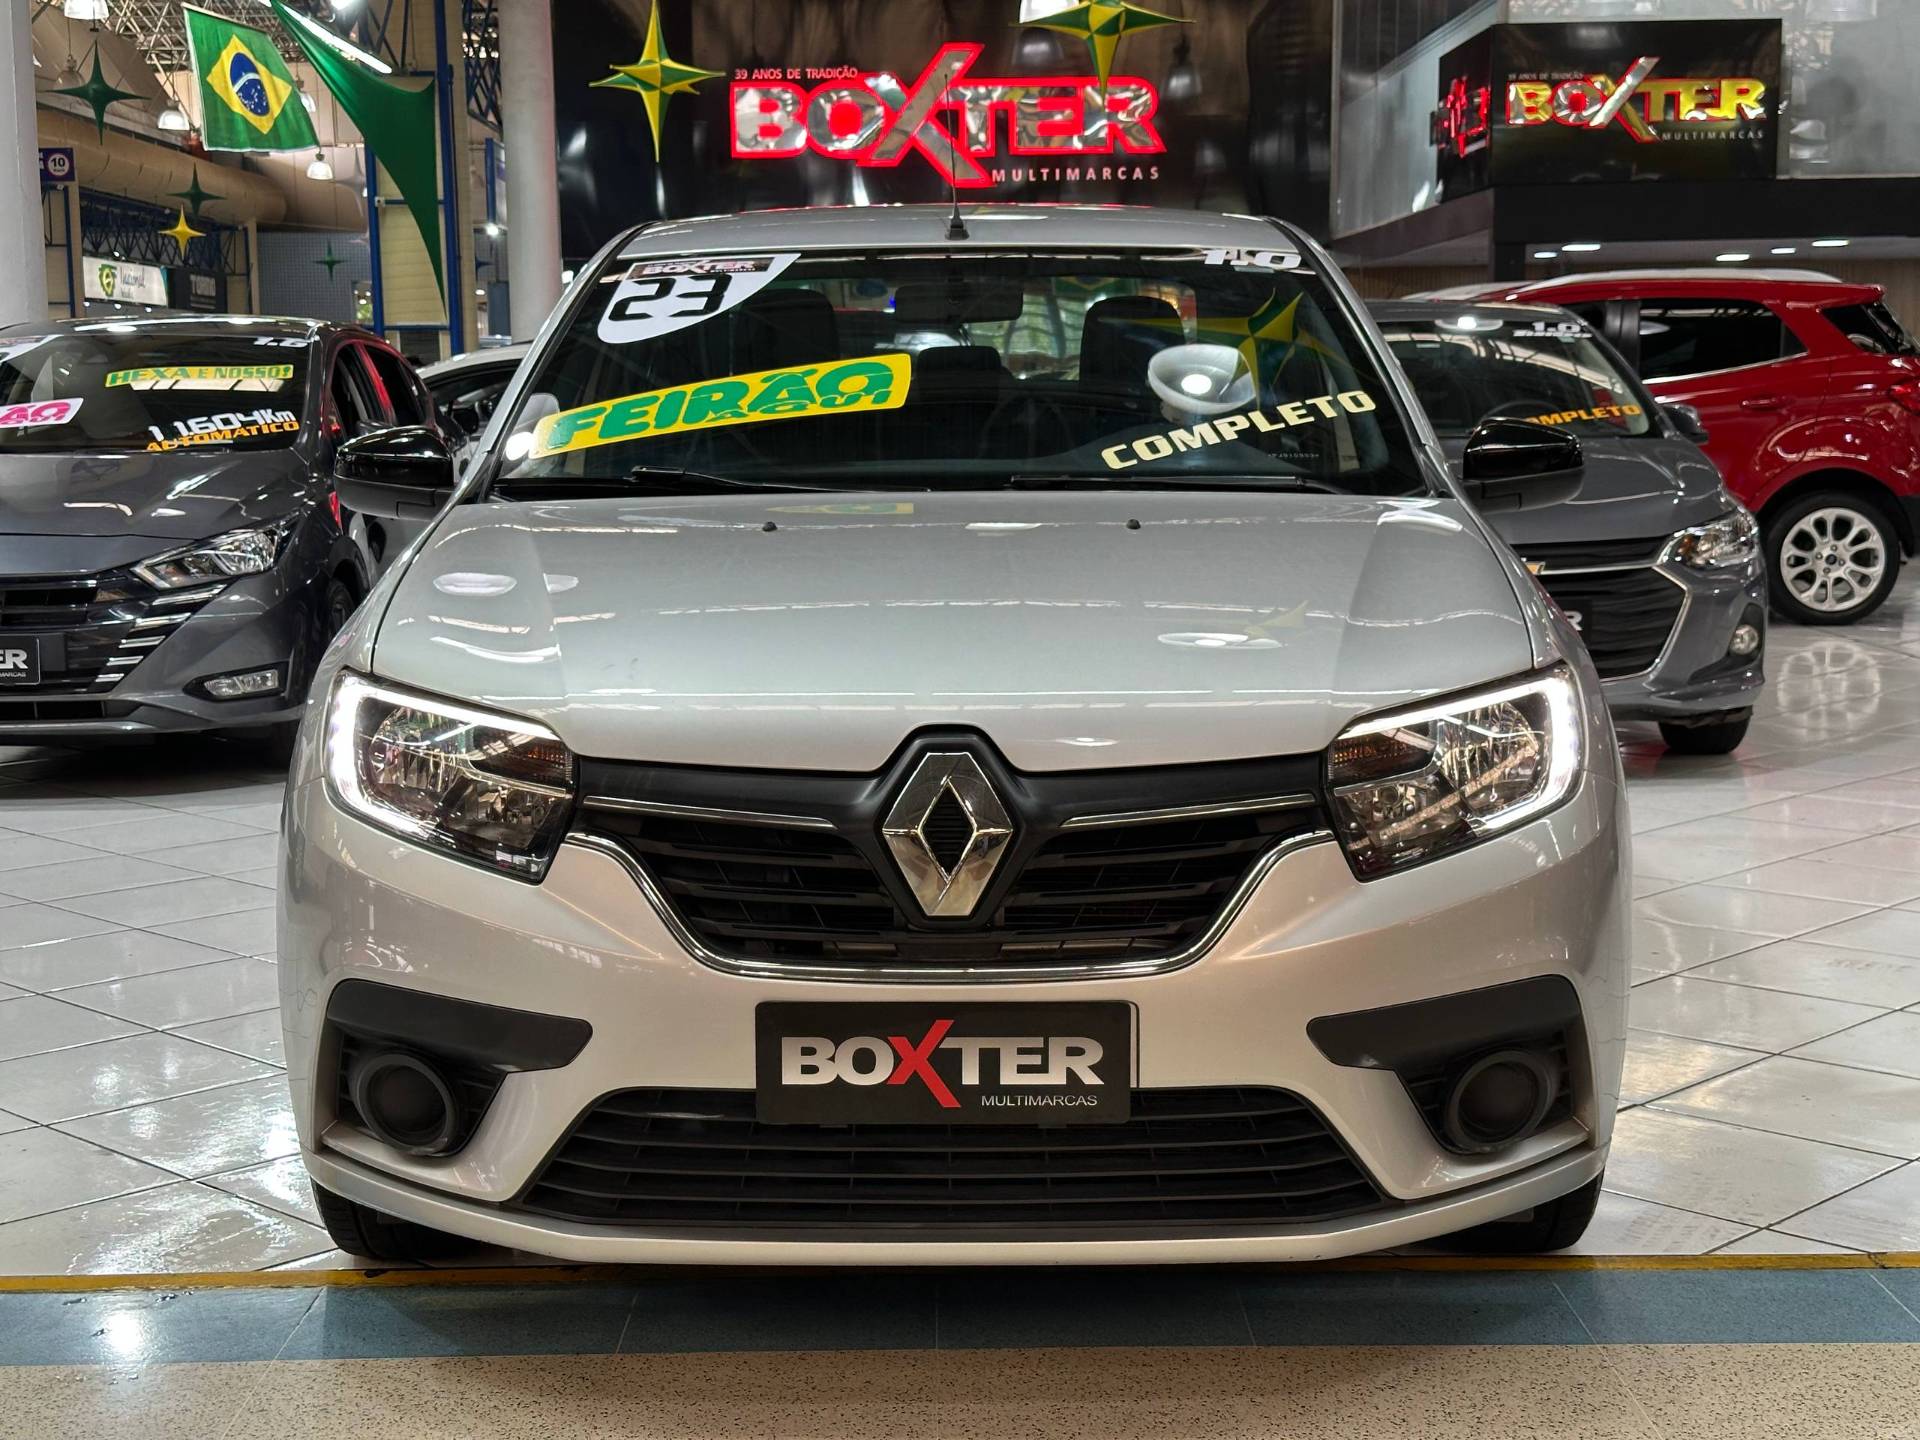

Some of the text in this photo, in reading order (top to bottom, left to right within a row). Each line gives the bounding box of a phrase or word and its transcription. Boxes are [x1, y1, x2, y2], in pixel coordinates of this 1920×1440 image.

[735, 65, 858, 81] 39 ANOS DE TRADIÇÃO
[1505, 56, 1767, 144] BOXTER
[729, 42, 1168, 188] BOXTER
[1662, 130, 1765, 142] MULTIMARCAS
[51, 157, 65, 168] 10
[991, 166, 1160, 183] MULTIMARCAS
[642, 258, 756, 277] BOXTER
[608, 273, 733, 322] 23
[109, 367, 192, 385] HEXA
[214, 366, 292, 379] NOSSO!
[546, 361, 895, 451] FEIRÃO
[1101, 389, 1377, 470] COMPLETO
[780, 1019, 1105, 1108] BOXTER
[981, 1094, 1098, 1107] MULTIMARCAS
